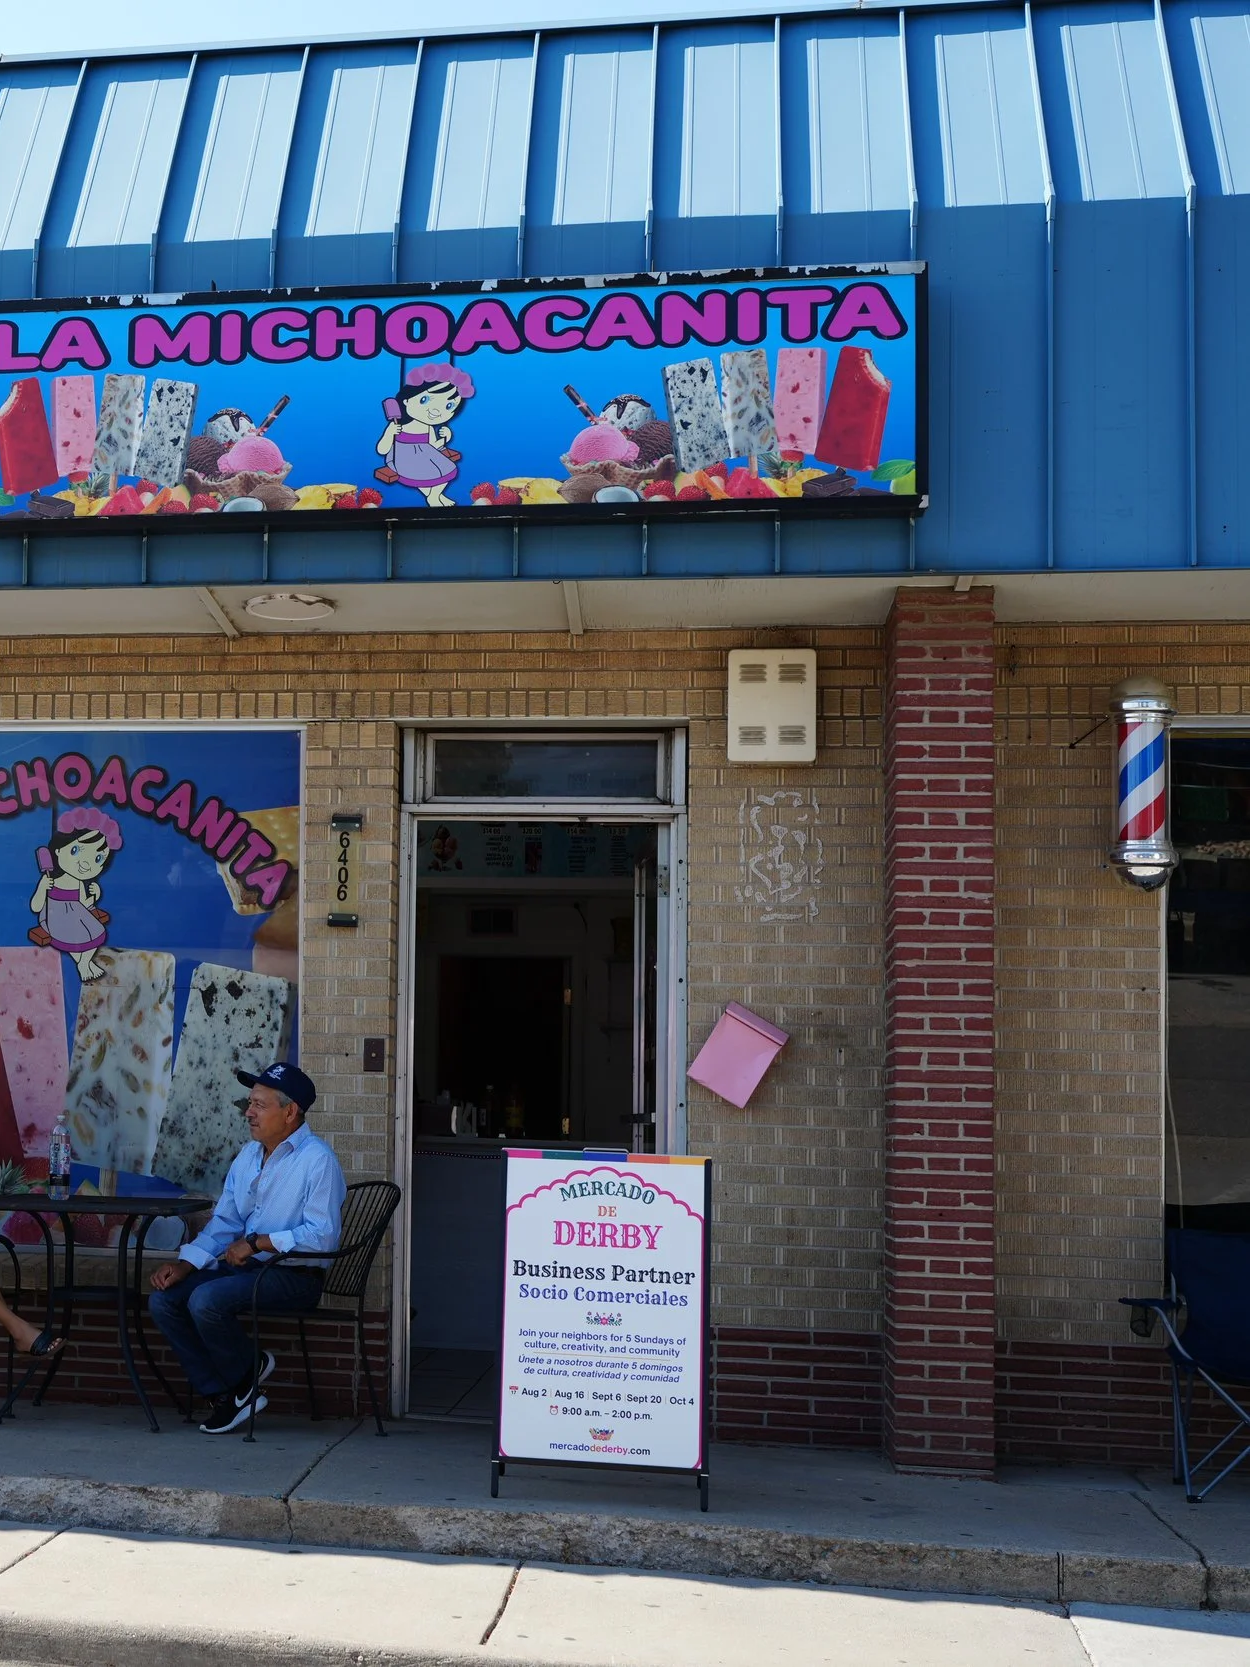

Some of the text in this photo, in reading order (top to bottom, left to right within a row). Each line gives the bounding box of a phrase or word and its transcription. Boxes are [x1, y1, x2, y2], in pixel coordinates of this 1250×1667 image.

[130, 282, 907, 366] MICHOACANITA
[337, 831, 350, 901] 6406
[559, 1180, 655, 1205] MERCADO
[598, 1205, 617, 1218] DE
[553, 1220, 663, 1250] DERBY
[512, 1259, 696, 1285] Business Partner
[519, 1284, 688, 1307] Socio Comerciales
[518, 1328, 686, 1346] Join your neighbors for 5 Sundays of
[524, 1340, 680, 1358] culture, creativity, and community
[518, 1354, 545, 1364] Únete
[554, 1358, 593, 1368] nosotros
[595, 1360, 630, 1370] durante
[631, 1362, 638, 1370] 5
[640, 1362, 684, 1374] domingos
[524, 1366, 680, 1383] de cultura, creatividad y comunidad
[522, 1388, 694, 1406] Aug 2 Aug 16 Sept 6 Sept 20 Oct 4
[562, 1406, 582, 1416] 9:00
[612, 1410, 632, 1419] 2:00
[634, 1412, 653, 1421] p.m.
[550, 1441, 650, 1456] mercadodederby.com
